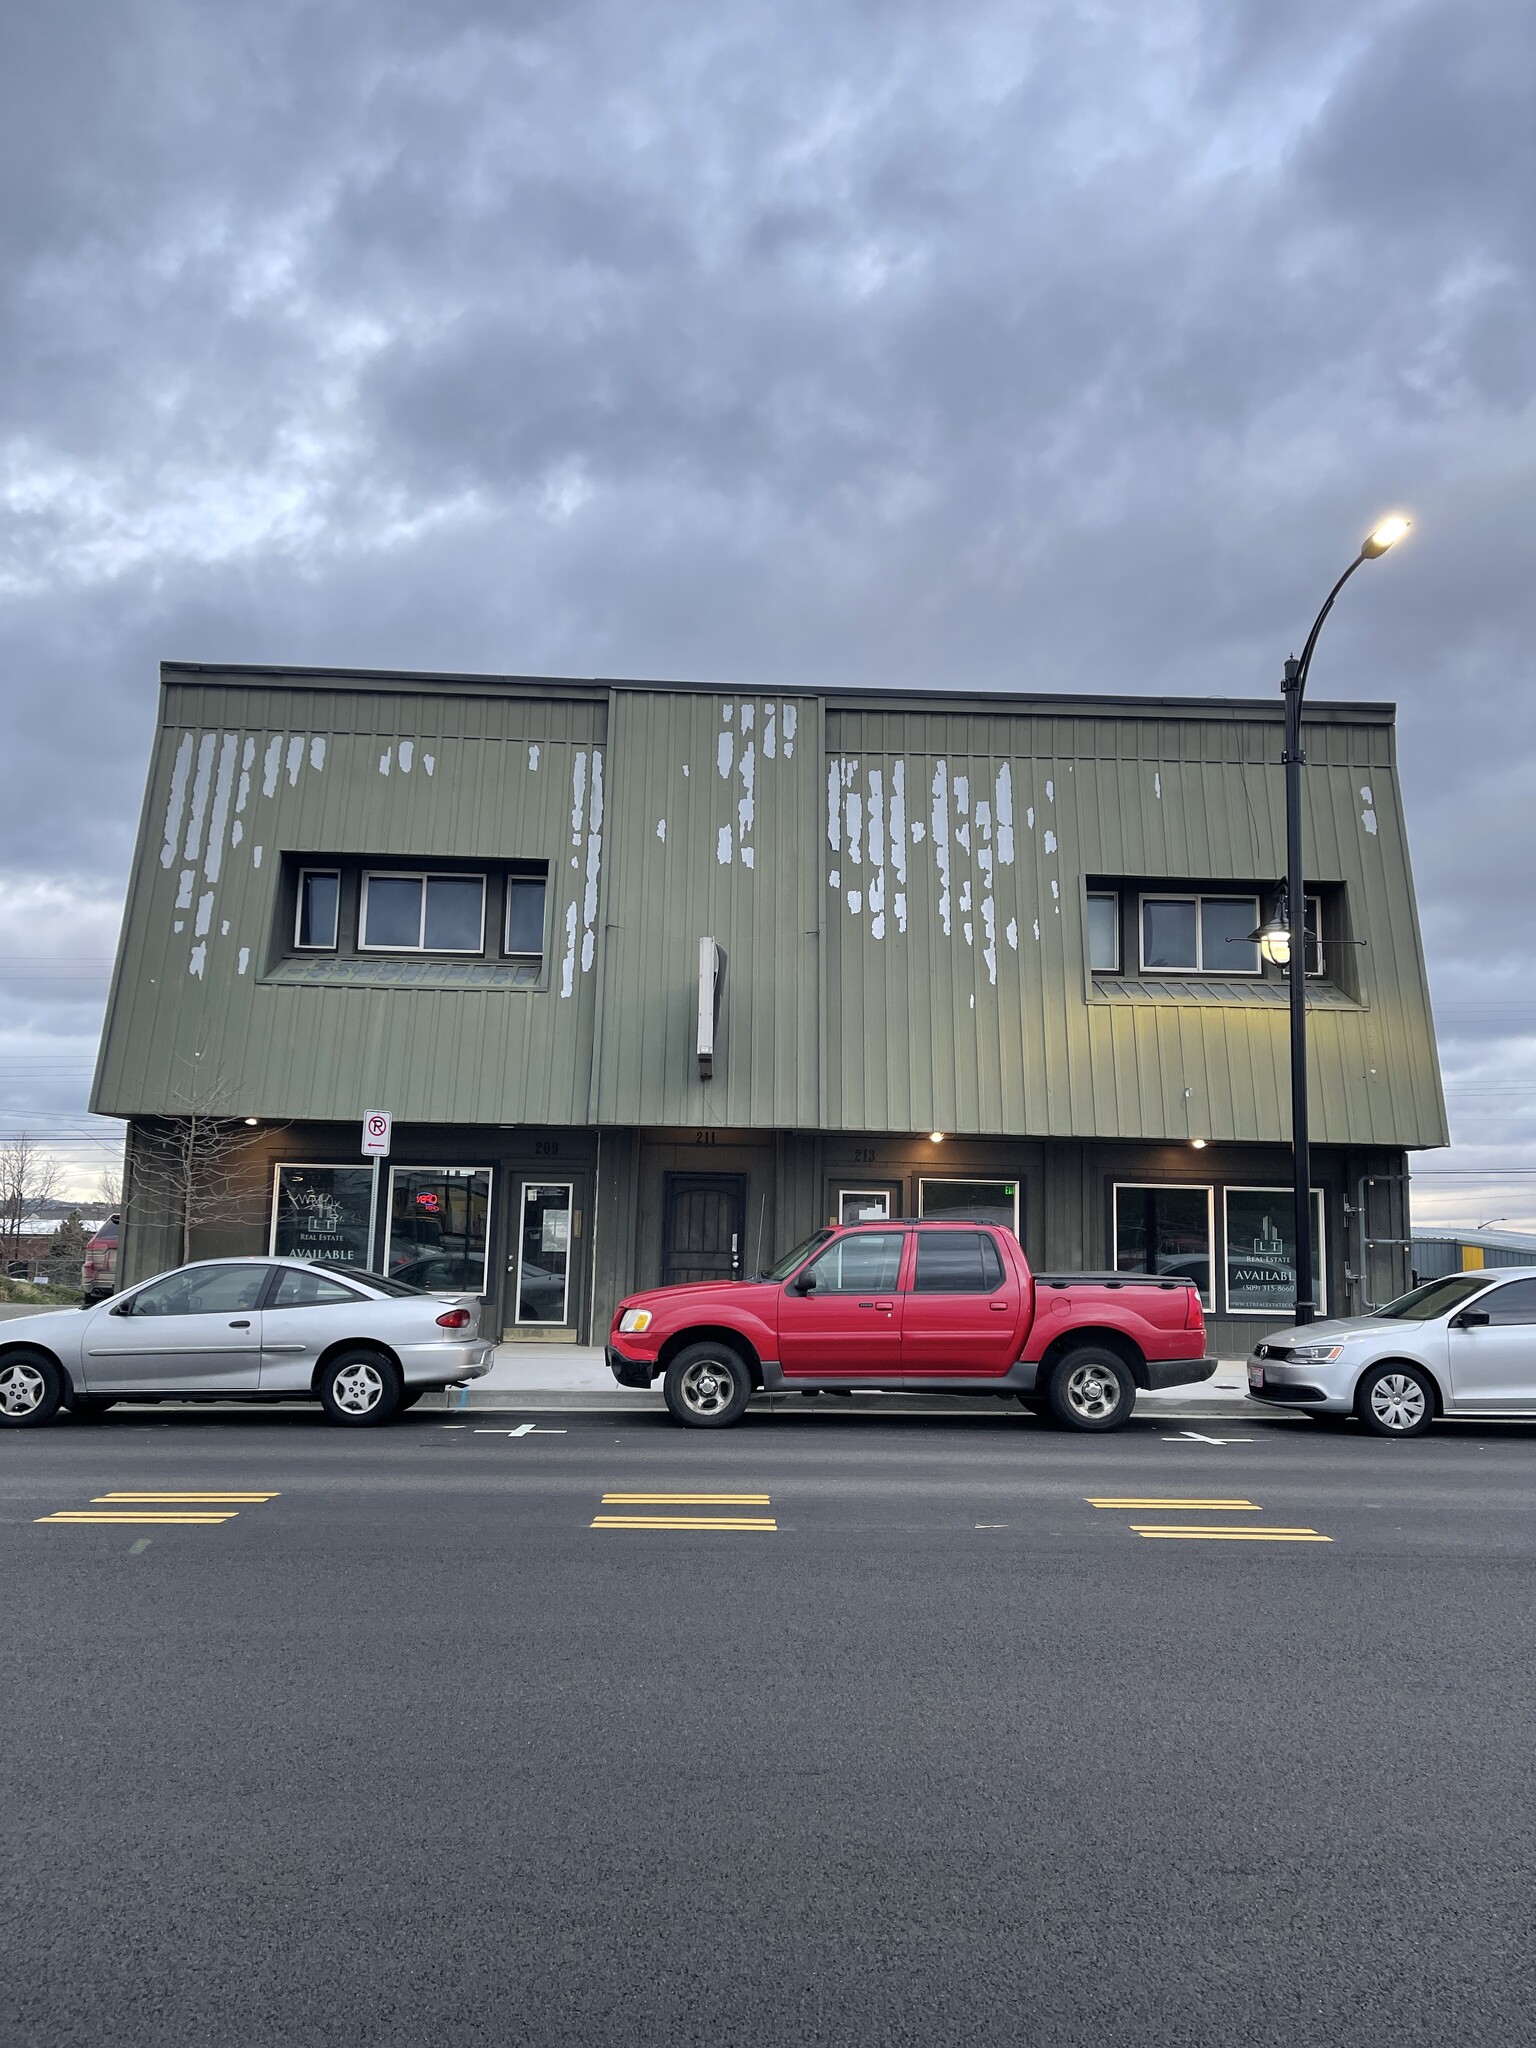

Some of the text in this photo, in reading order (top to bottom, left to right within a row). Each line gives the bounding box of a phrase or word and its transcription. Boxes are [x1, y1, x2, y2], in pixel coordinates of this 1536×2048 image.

[696, 1131, 715, 1144] 211
[535, 1141, 559, 1155] 209
[855, 1149, 876, 1162] 213
[289, 1248, 354, 1260] AVAILABLE
[1235, 1271, 1295, 1281] AVAILABL
